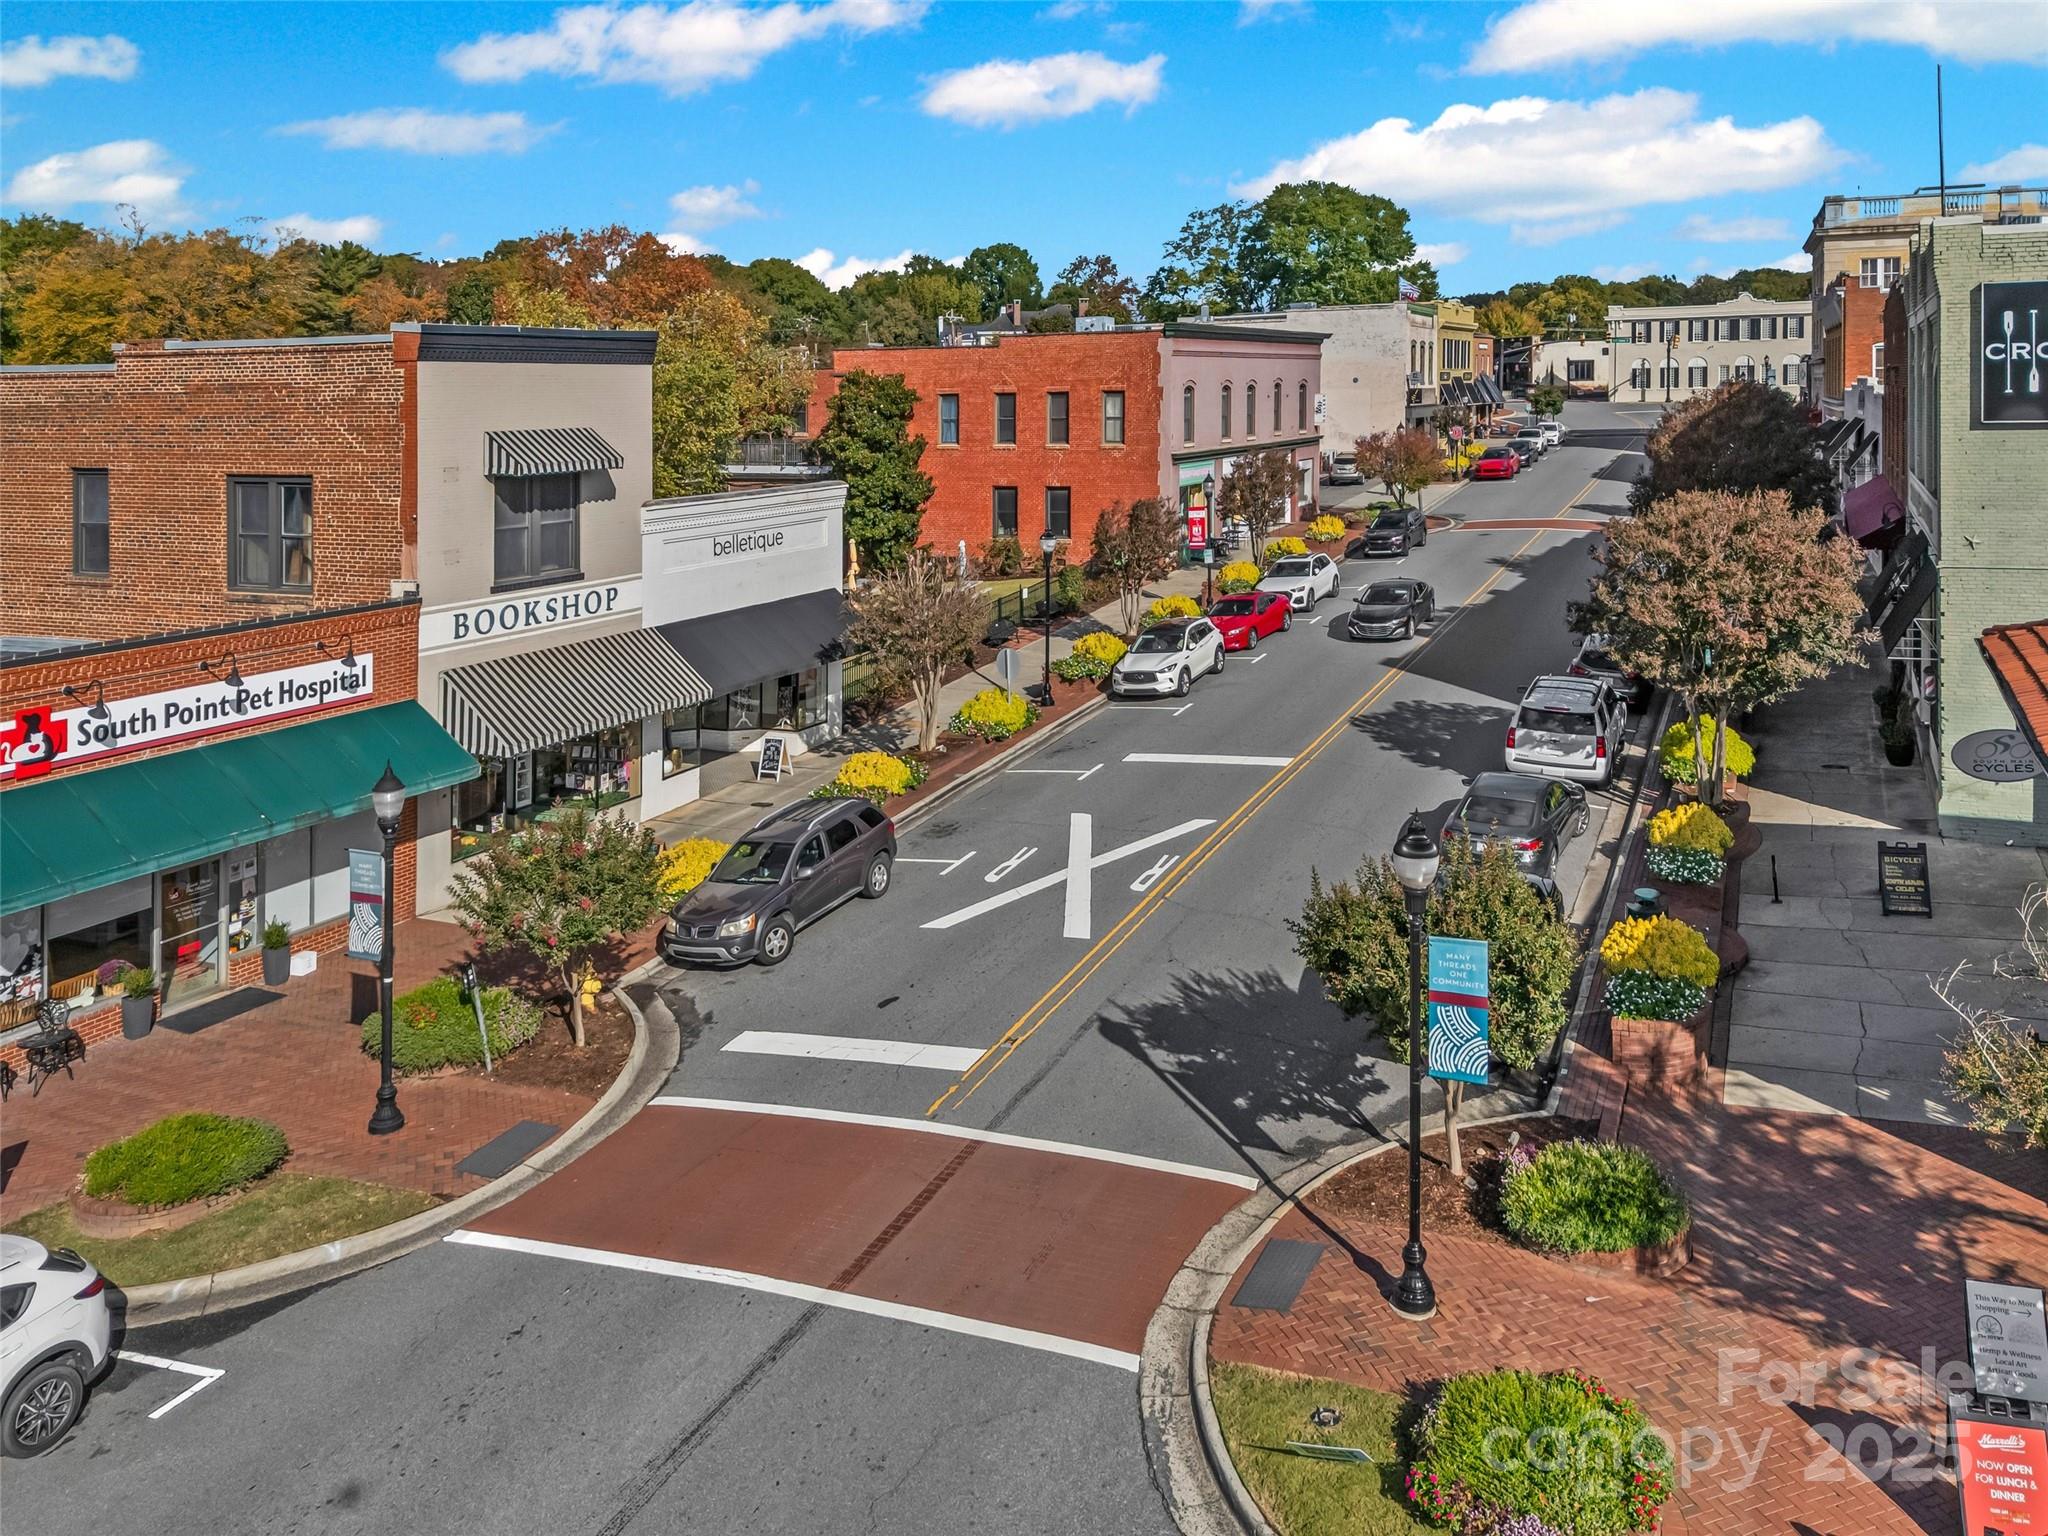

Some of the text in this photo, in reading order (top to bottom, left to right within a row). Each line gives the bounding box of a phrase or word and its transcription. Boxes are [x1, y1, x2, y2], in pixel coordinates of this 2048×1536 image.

[713, 531, 784, 557] belletique
[453, 587, 619, 639] BOOKSHOP
[77, 664, 367, 747] South Point Pet Hospital
[1973, 764, 2034, 773] CYCLES
[1446, 953, 1471, 961] MANY
[1449, 970, 1468, 978] ONE
[1432, 977, 1485, 989] COMMUNITY
[1974, 1294, 1990, 1302] This
[1991, 1296, 2007, 1305] Way
[1975, 1304, 2010, 1315] Shopping
[2009, 1350, 2042, 1361] Wellness
[1995, 1357, 2014, 1367] Local
[1987, 1366, 2037, 1379] Artisan Goods
[1976, 1459, 2033, 1475] NOW OPEN
[1975, 1473, 2038, 1490] FOR LUNCH &
[1990, 1489, 2026, 1503] DINNER
